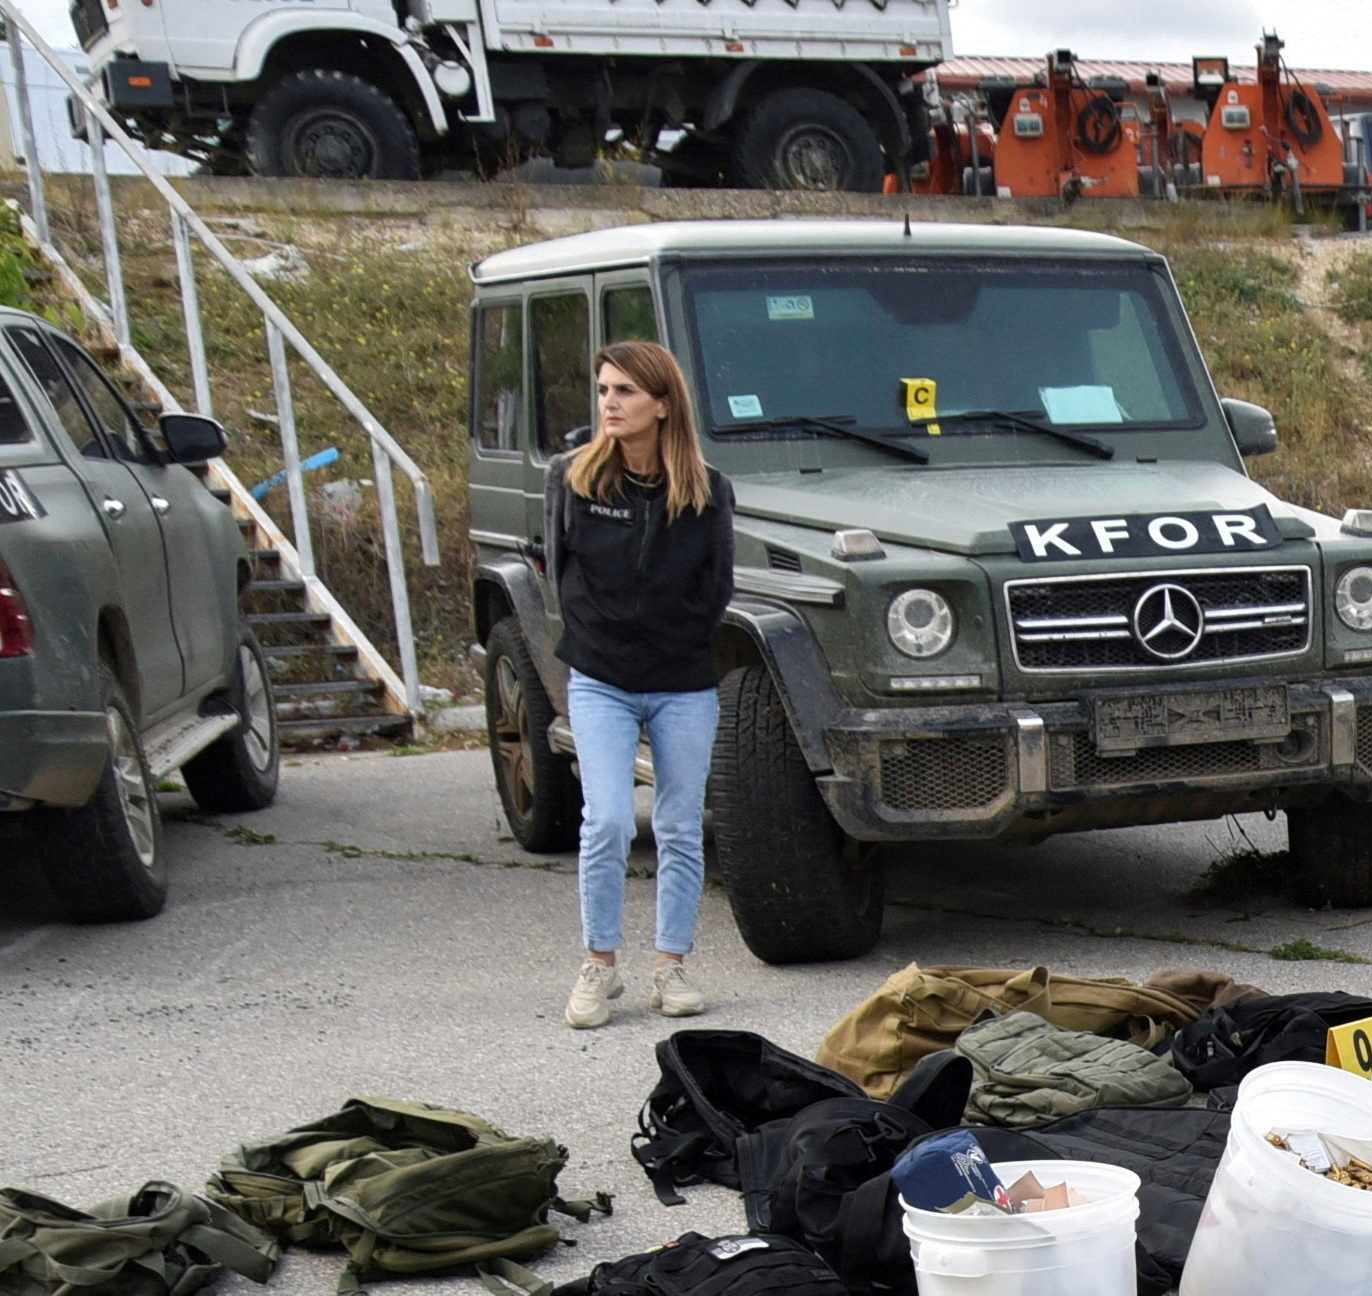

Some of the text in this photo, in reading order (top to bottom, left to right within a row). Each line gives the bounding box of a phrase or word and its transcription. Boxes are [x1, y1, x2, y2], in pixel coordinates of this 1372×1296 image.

[914, 387, 930, 404] C
[589, 503, 631, 519] POLICE
[1023, 514, 1268, 558] KFOR
